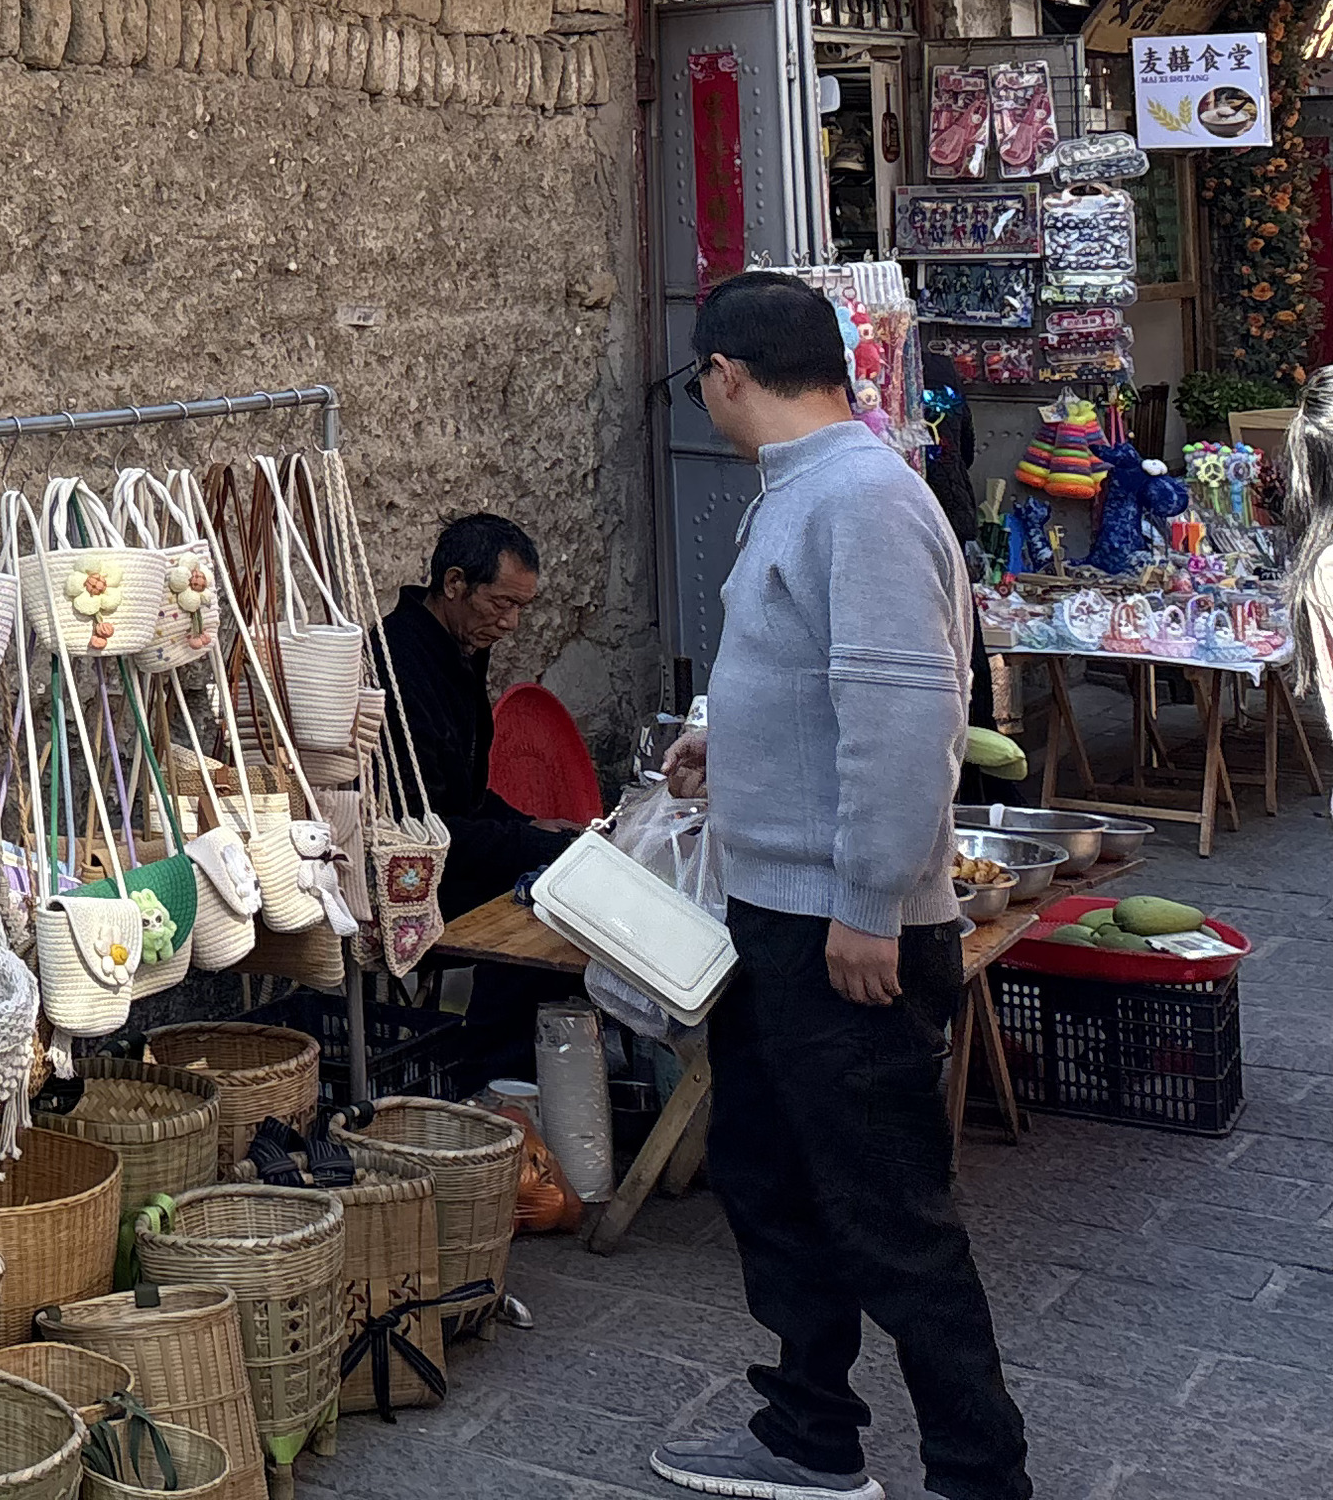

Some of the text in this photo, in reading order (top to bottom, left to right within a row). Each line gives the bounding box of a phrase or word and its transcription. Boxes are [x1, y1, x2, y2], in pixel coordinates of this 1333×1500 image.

[1139, 43, 1253, 75] 麦囍食堂
[1185, 74, 1209, 83] TANG
